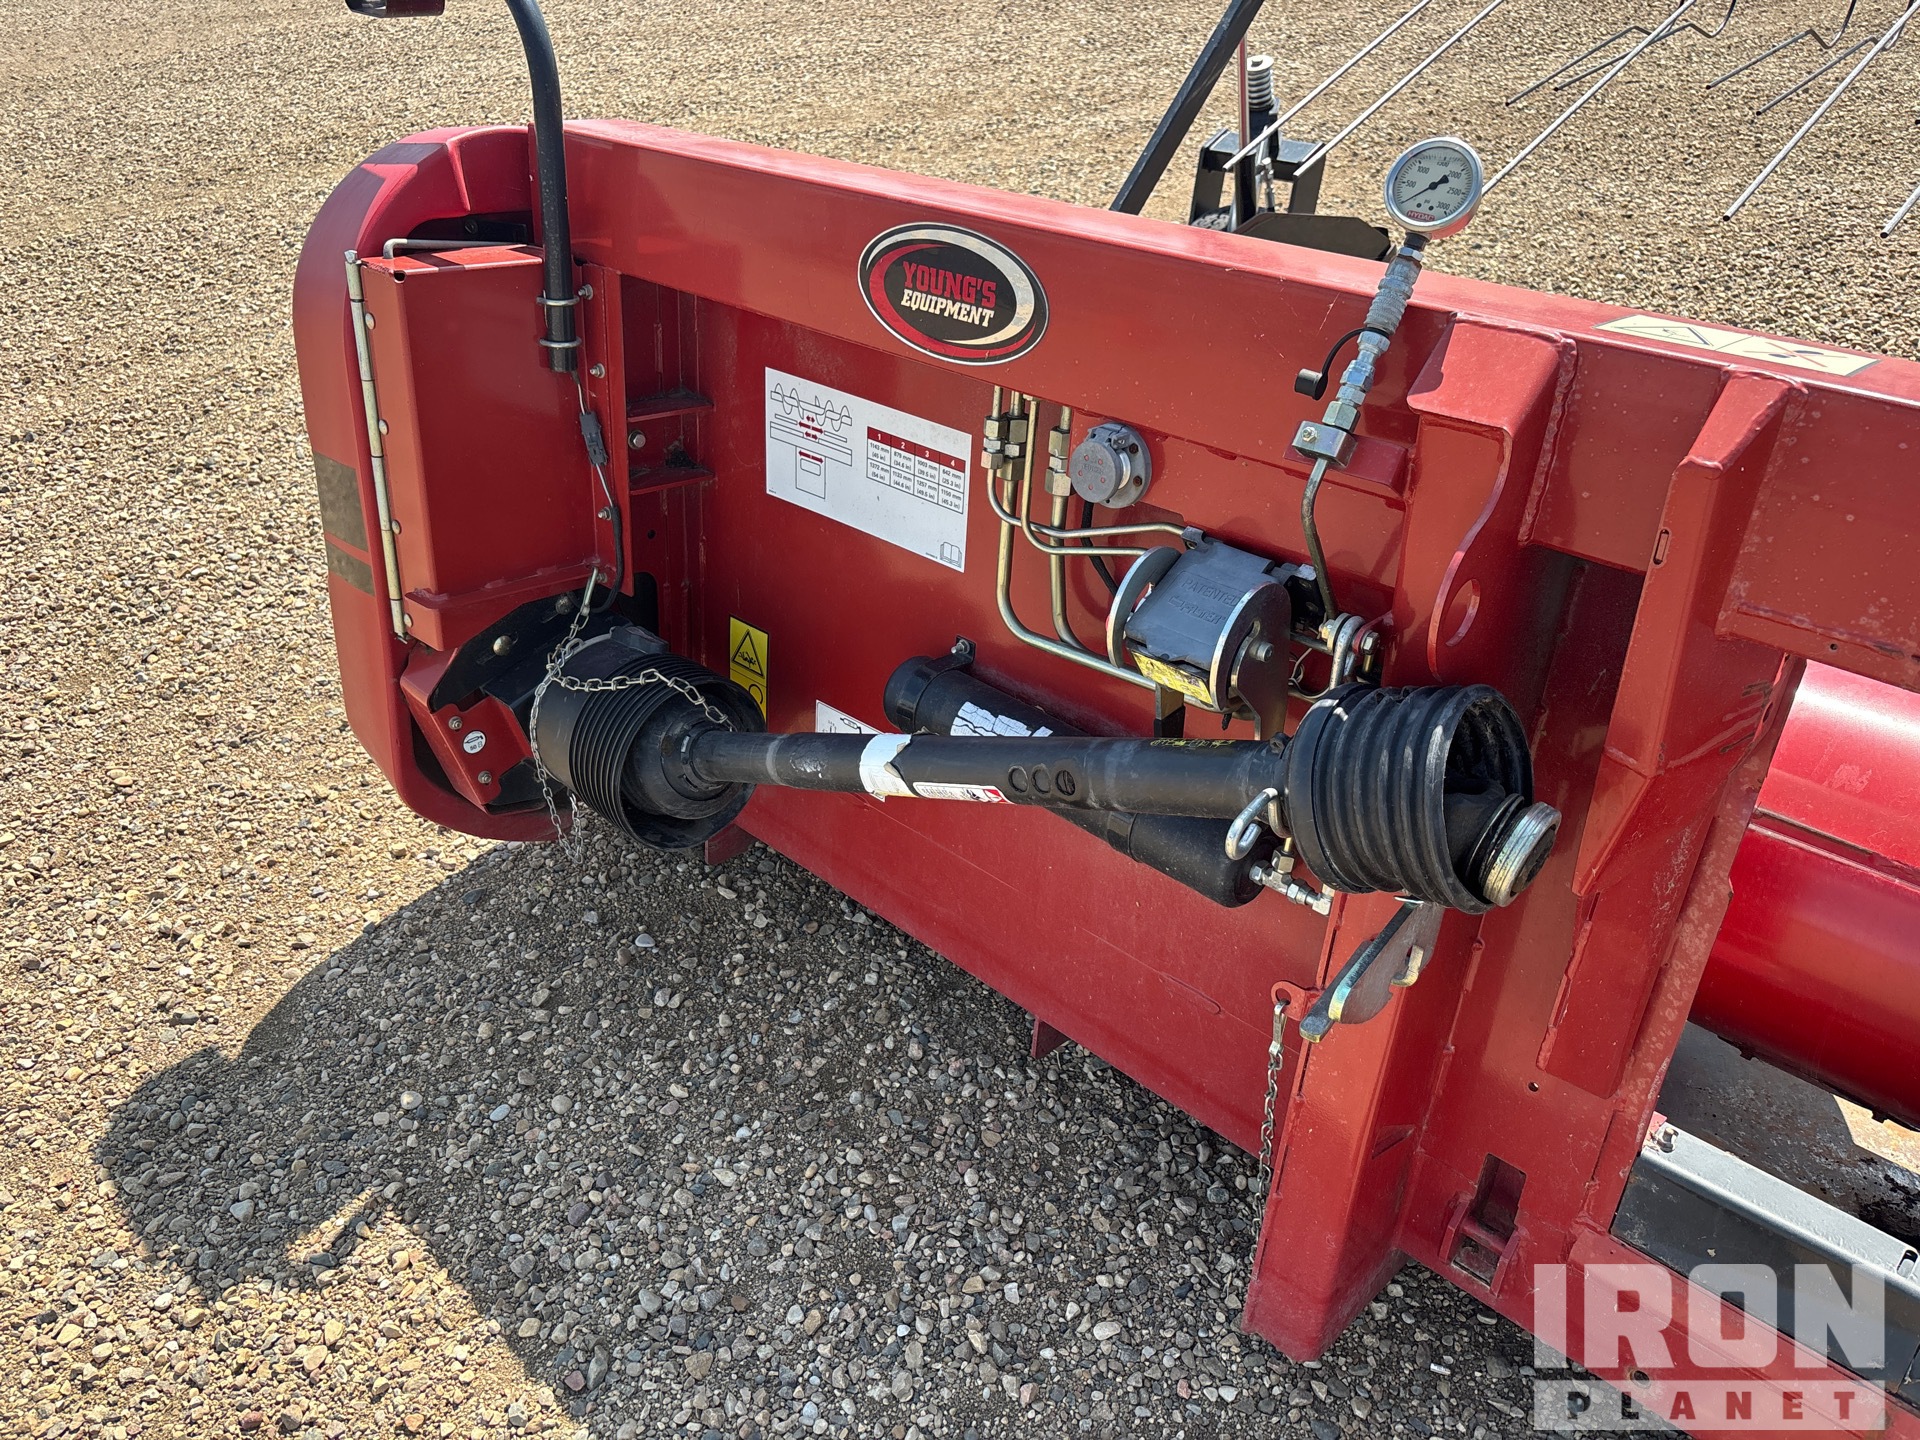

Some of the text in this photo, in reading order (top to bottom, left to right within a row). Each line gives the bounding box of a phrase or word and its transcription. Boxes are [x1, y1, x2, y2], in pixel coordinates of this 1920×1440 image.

[1417, 166, 1429, 174] 1000
[1447, 170, 1461, 179] 2000
[1405, 180, 1416, 188] 500
[1447, 187, 1461, 196] 2500
[1436, 201, 1450, 210] 3000
[1408, 210, 1434, 221] HYDAC
[903, 261, 996, 308] YOUNG'S
[901, 289, 994, 327] EQUIPMENT
[1181, 578, 1239, 606] PATENTED
